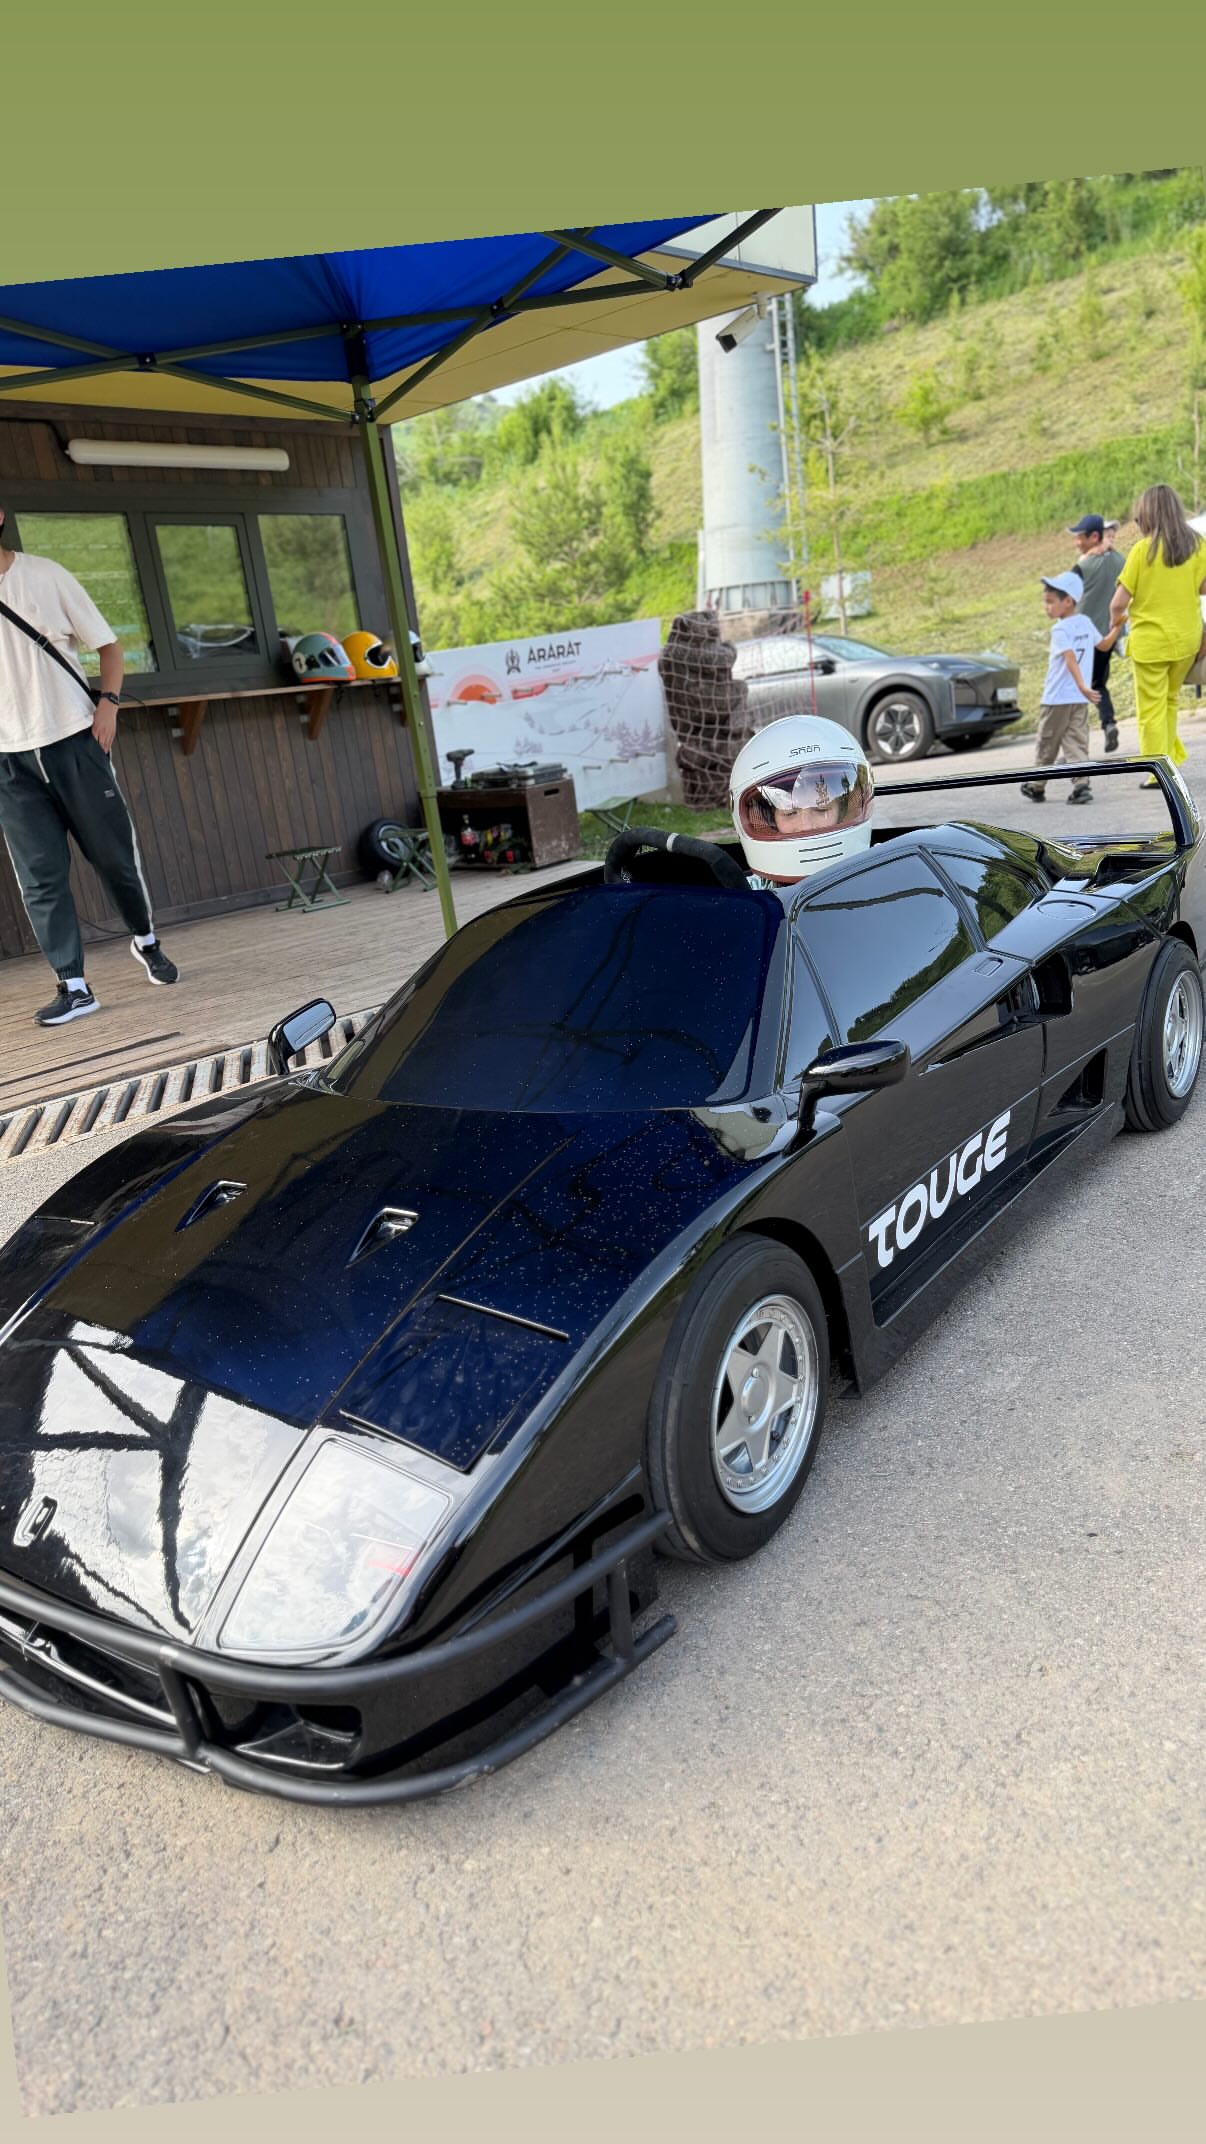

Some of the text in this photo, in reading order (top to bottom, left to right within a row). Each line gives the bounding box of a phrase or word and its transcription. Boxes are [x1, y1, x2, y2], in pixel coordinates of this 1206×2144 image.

[528, 641, 581, 664] ARARAT
[1076, 648, 1085, 664] 7
[868, 1110, 1011, 1268] TOUGE
